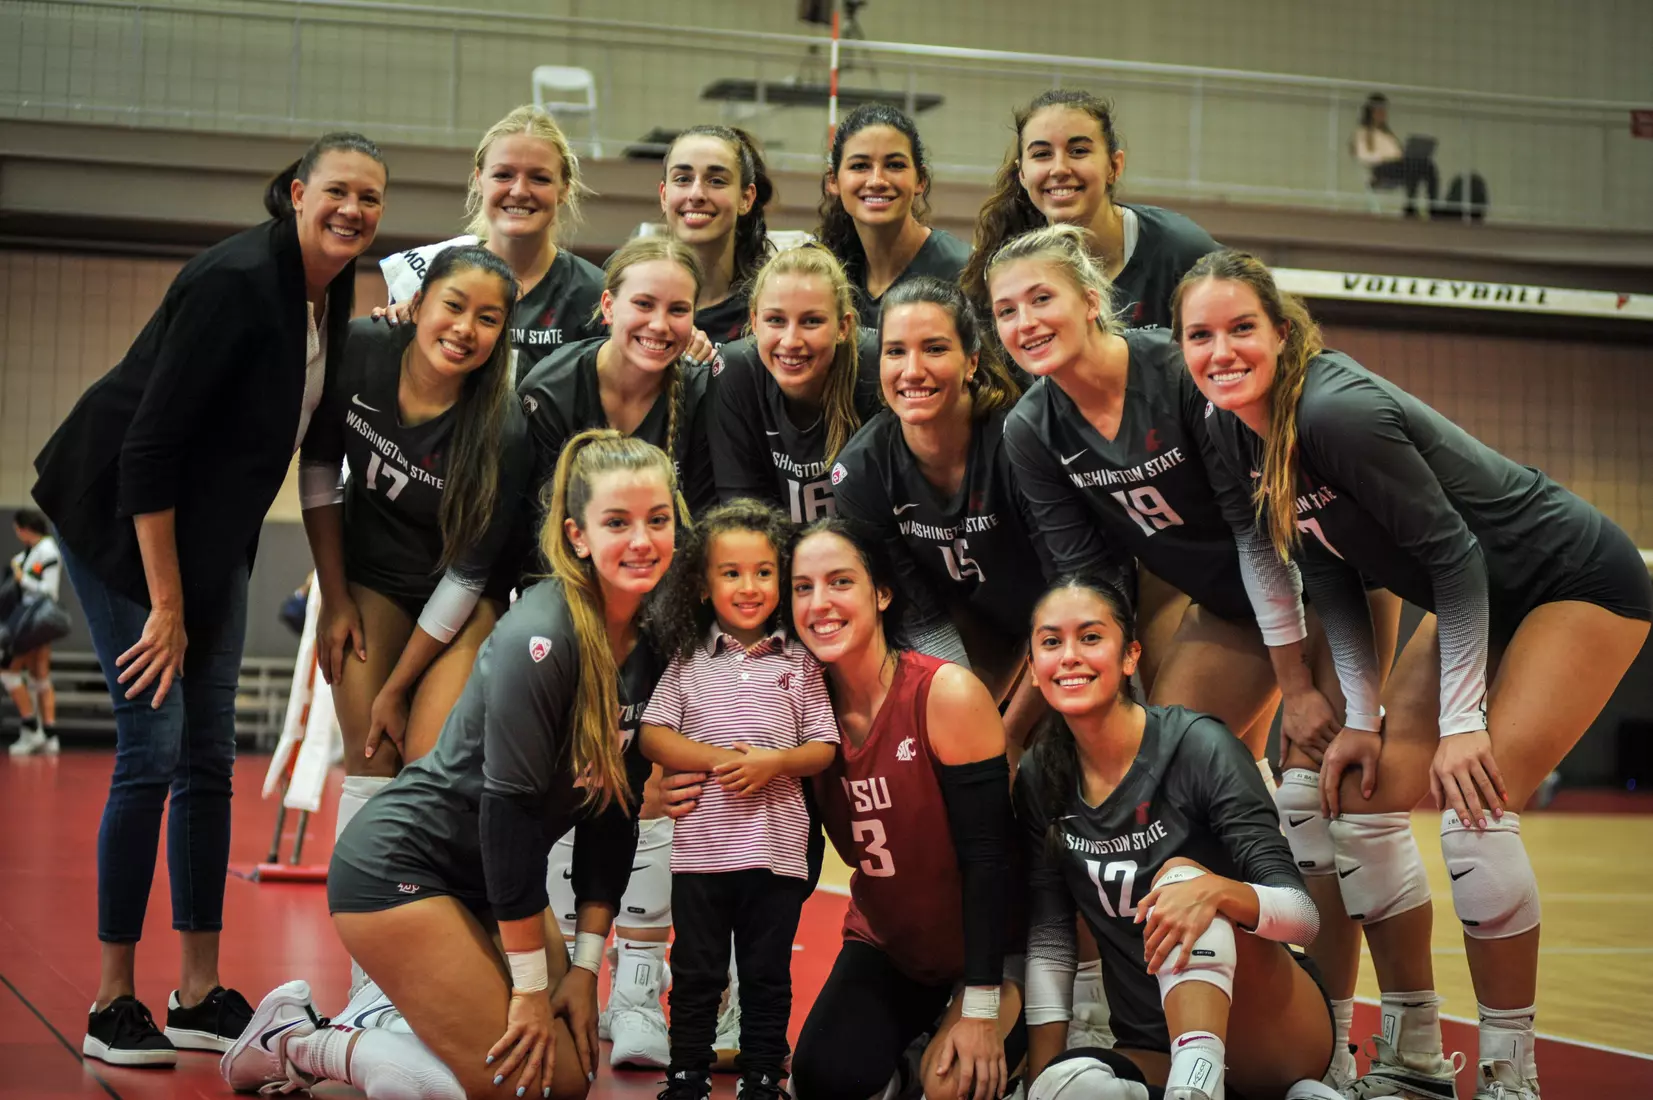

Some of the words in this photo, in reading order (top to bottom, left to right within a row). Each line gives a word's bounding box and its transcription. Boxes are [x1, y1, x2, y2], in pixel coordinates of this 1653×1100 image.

[1343, 274, 1547, 304] VOLLEYBALL
[529, 329, 563, 344] STATE
[366, 451, 409, 501] 17
[410, 464, 445, 490] STATE
[1144, 447, 1186, 477] STATE
[1110, 485, 1185, 538] 19
[1308, 486, 1338, 510] TATE
[965, 513, 999, 533] STATE
[840, 776, 892, 813] SU
[851, 818, 896, 877] 3
[1061, 832, 1131, 855] SHINGTON
[1132, 820, 1168, 850] STATE
[1084, 859, 1138, 918] 12
